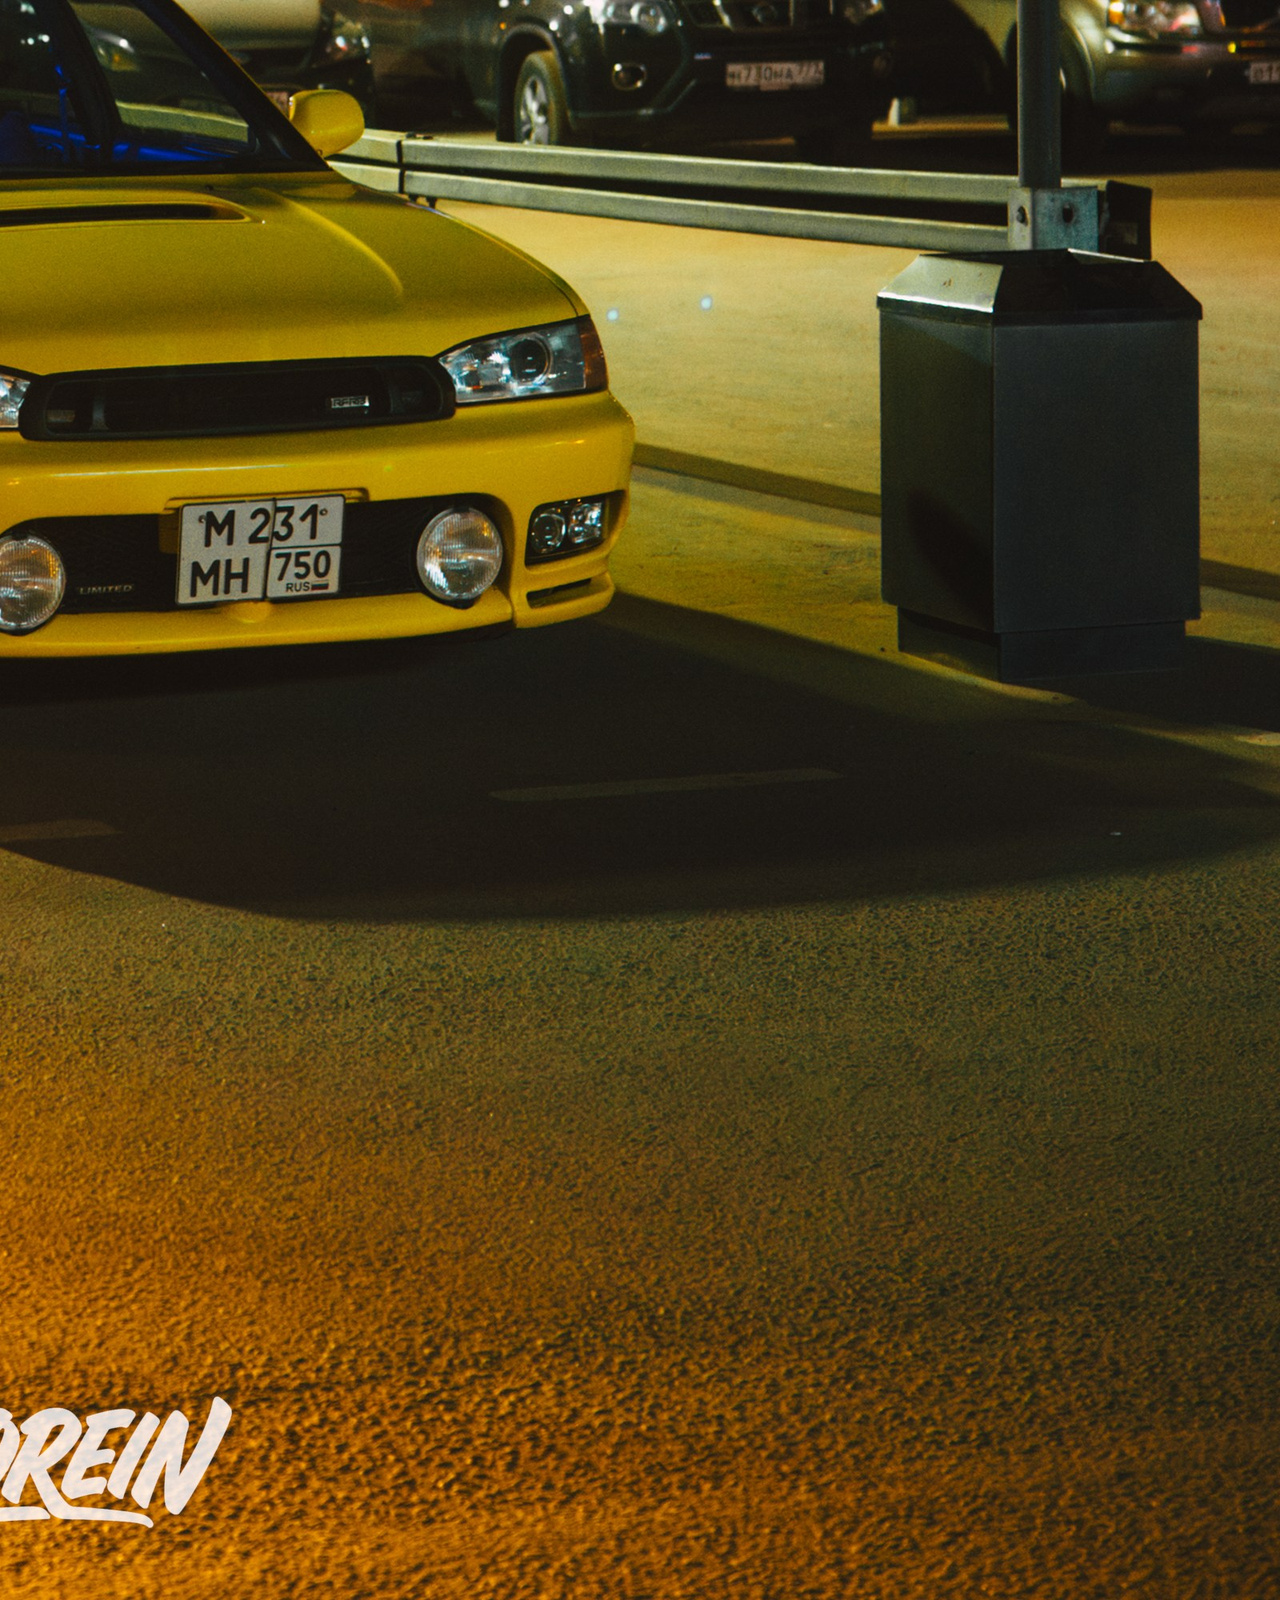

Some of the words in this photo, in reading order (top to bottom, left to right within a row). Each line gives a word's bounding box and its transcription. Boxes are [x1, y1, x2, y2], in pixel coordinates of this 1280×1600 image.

[248, 503, 319, 545] 231
[190, 557, 250, 598] МН
[275, 549, 331, 582] 750
[286, 581, 311, 593] RUS
[80, 584, 133, 595] LIMITED
